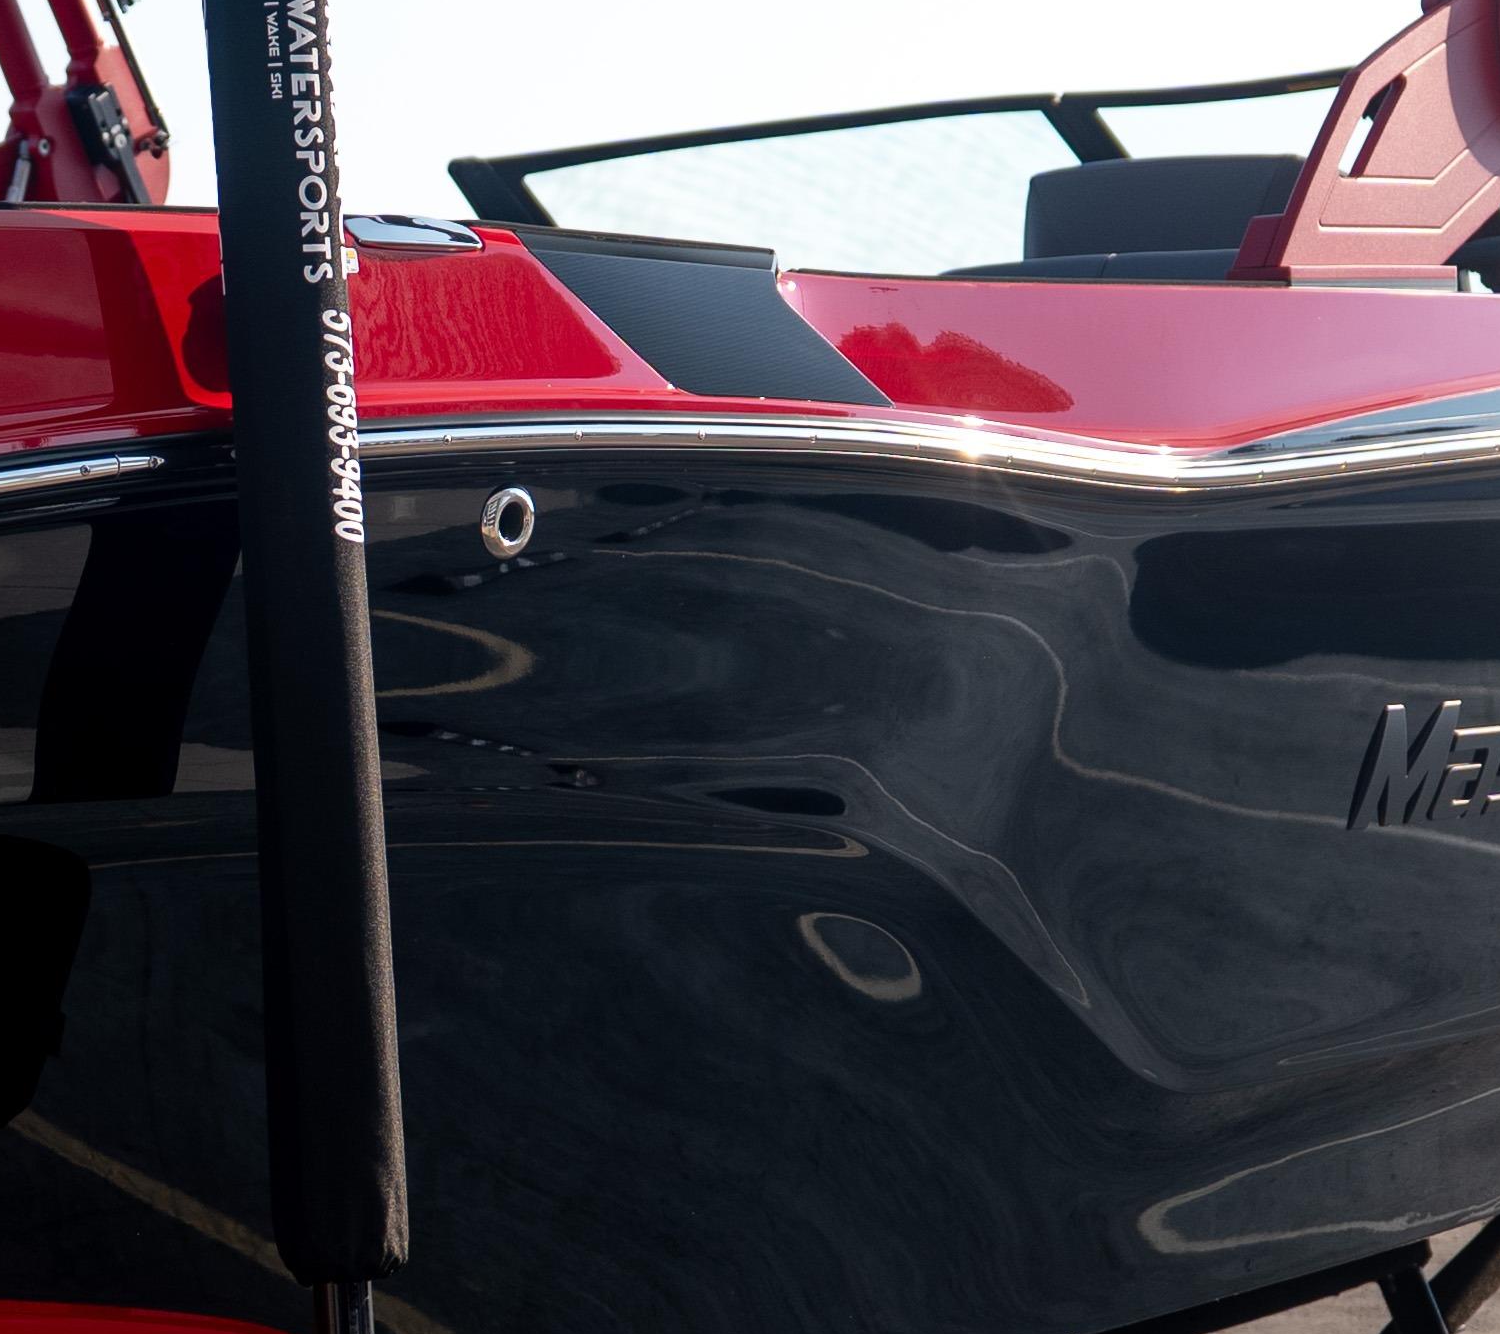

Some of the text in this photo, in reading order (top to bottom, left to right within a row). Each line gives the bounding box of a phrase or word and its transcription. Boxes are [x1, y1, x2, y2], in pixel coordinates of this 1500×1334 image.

[266, 11, 281, 58] WAKE
[270, 71, 284, 100] SKI
[321, 308, 365, 544] 573-693-9400
